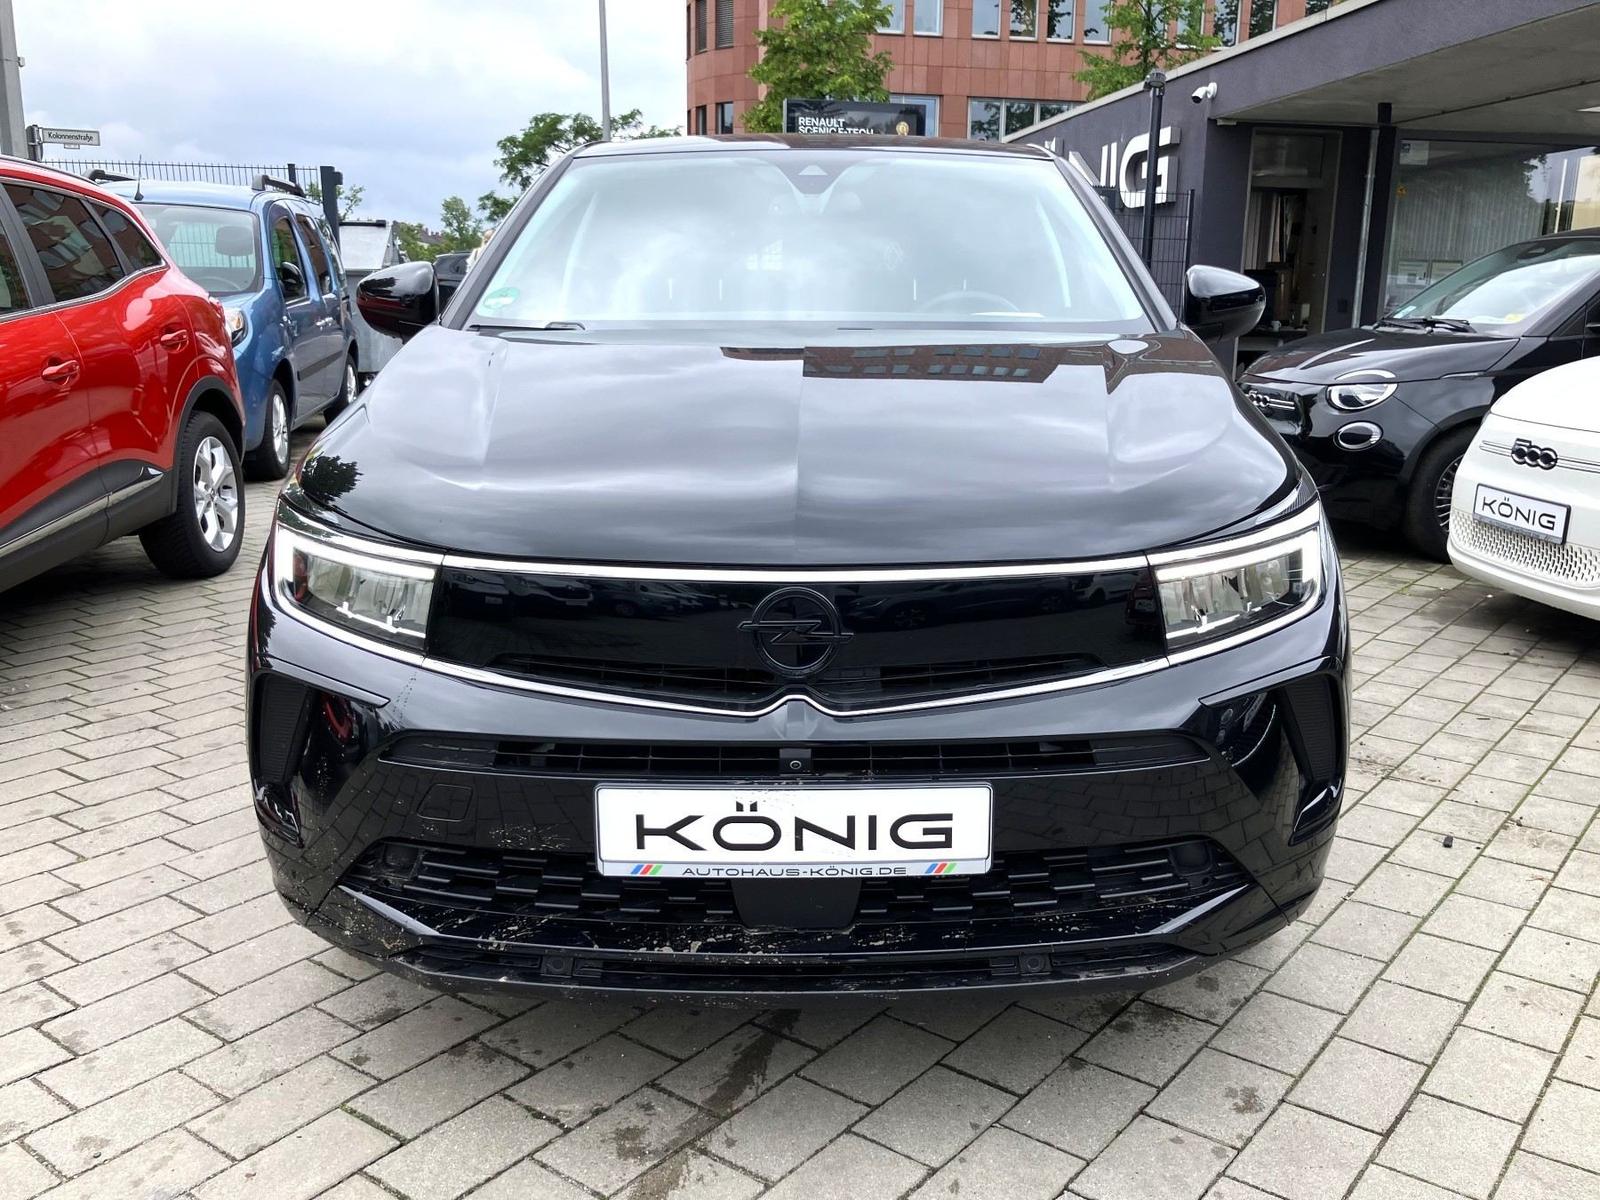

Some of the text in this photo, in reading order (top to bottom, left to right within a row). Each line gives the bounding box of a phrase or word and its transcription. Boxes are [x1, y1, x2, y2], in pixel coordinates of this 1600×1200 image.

[798, 117, 845, 127] RENAULT
[48, 131, 94, 142] Kolonnenstraße
[1511, 438, 1558, 470] 500
[1481, 496, 1557, 531] KÖNIG
[635, 800, 954, 852] KÖNIG
[682, 865, 907, 877] AUTOHAUS-KÖNIG.DE
